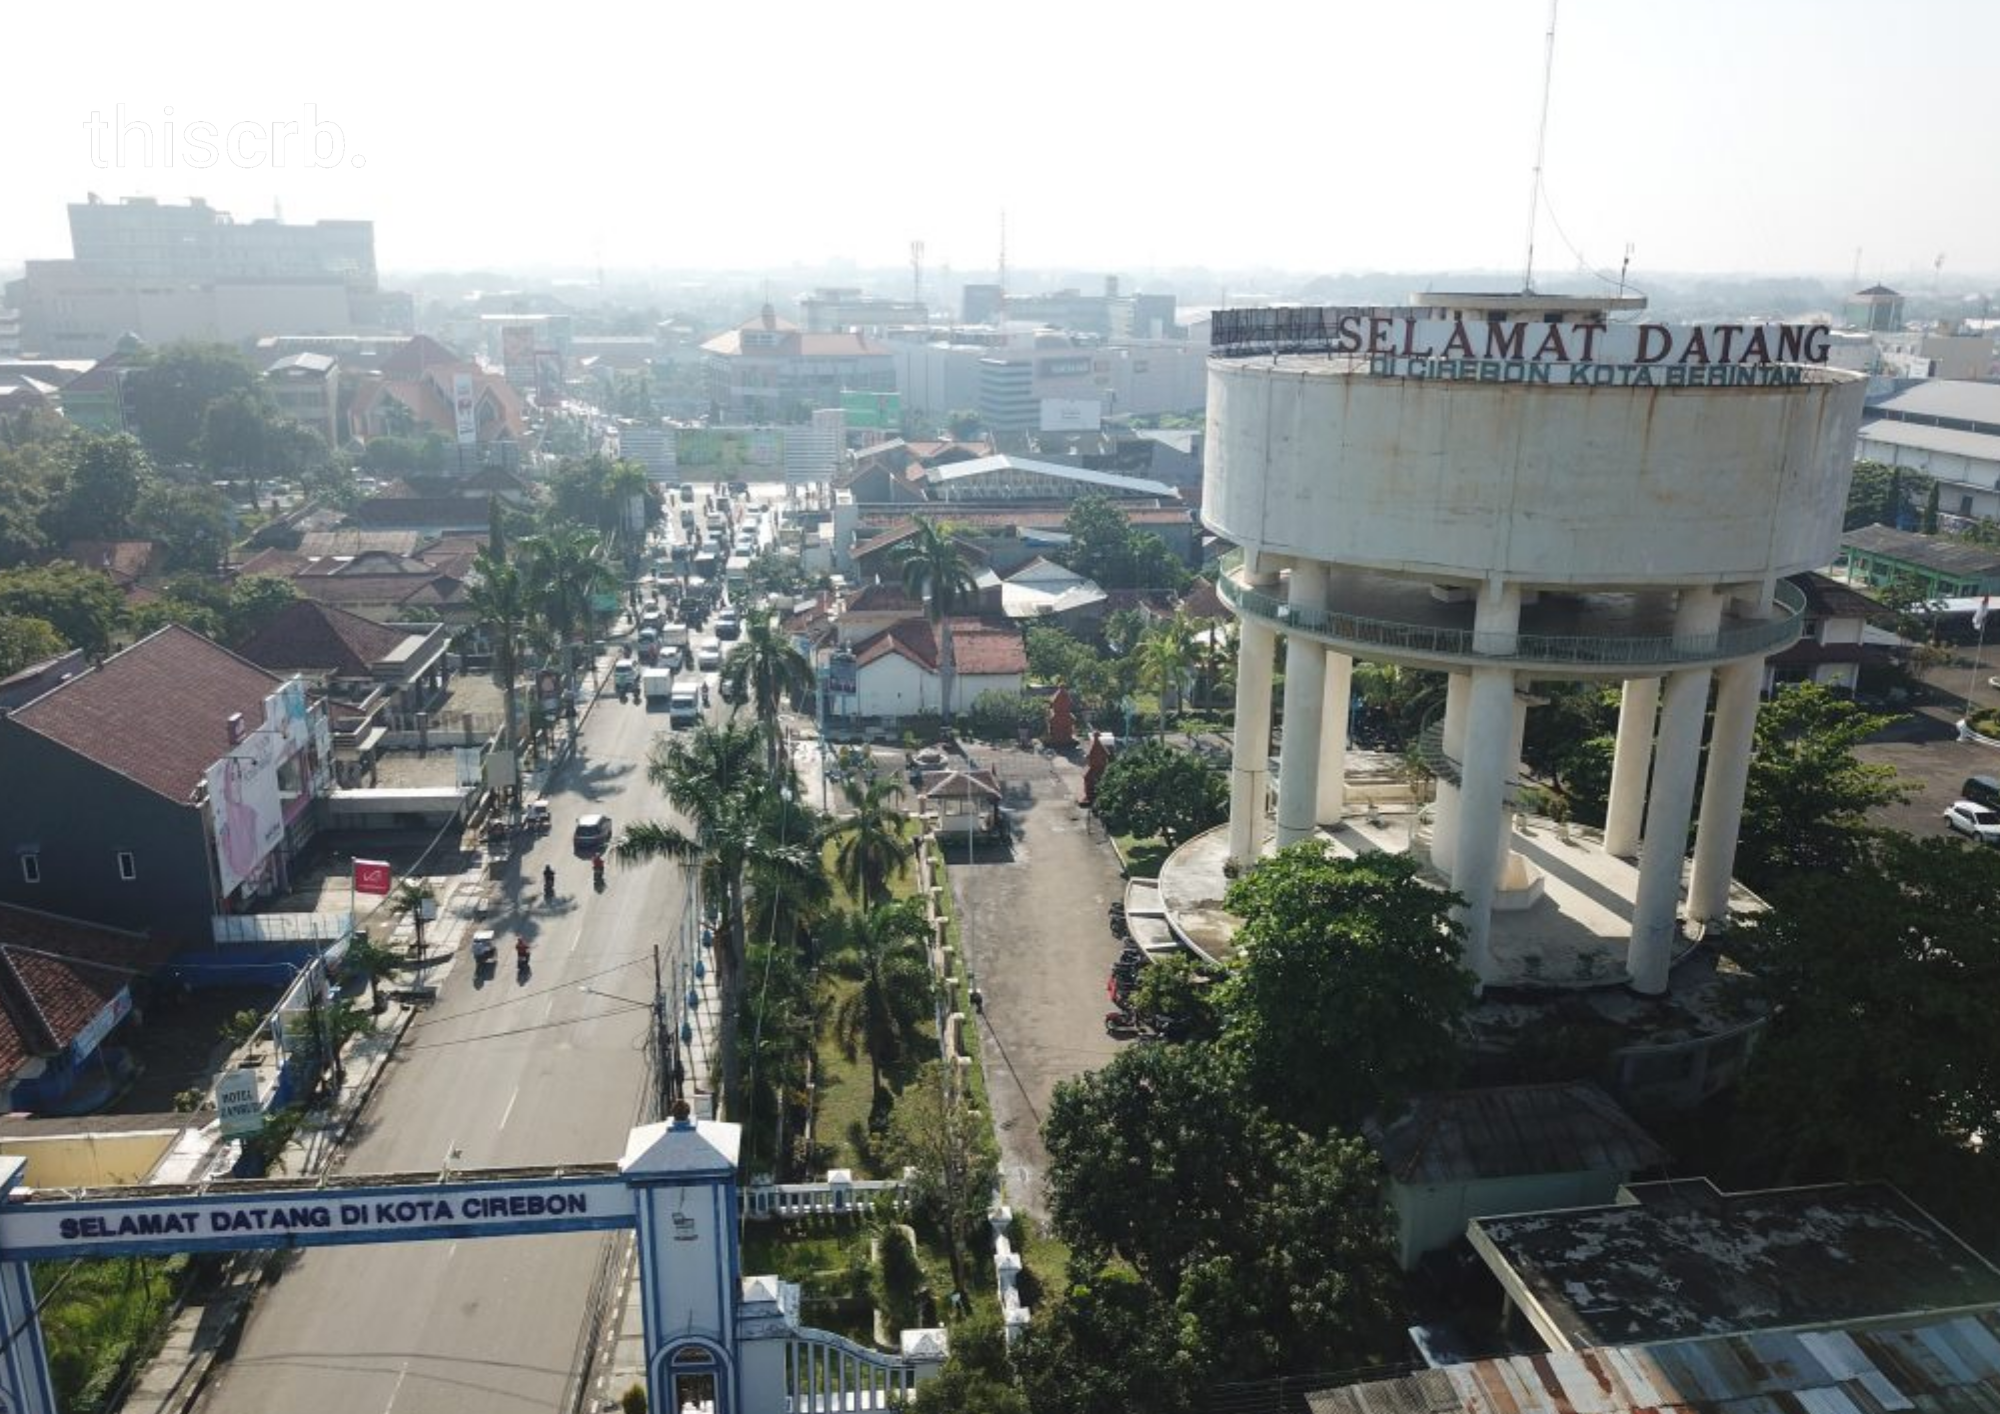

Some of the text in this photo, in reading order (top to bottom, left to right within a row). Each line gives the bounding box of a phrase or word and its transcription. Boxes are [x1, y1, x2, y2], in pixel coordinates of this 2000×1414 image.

[1338, 315, 1831, 364] SELAMAT DATANG
[1369, 356, 1396, 377] DI
[1408, 357, 1550, 383] CIREBON
[1570, 364, 1651, 386] KOTA
[60, 1193, 587, 1239] SELAMAT DATANG DI KOTA CIREBON
